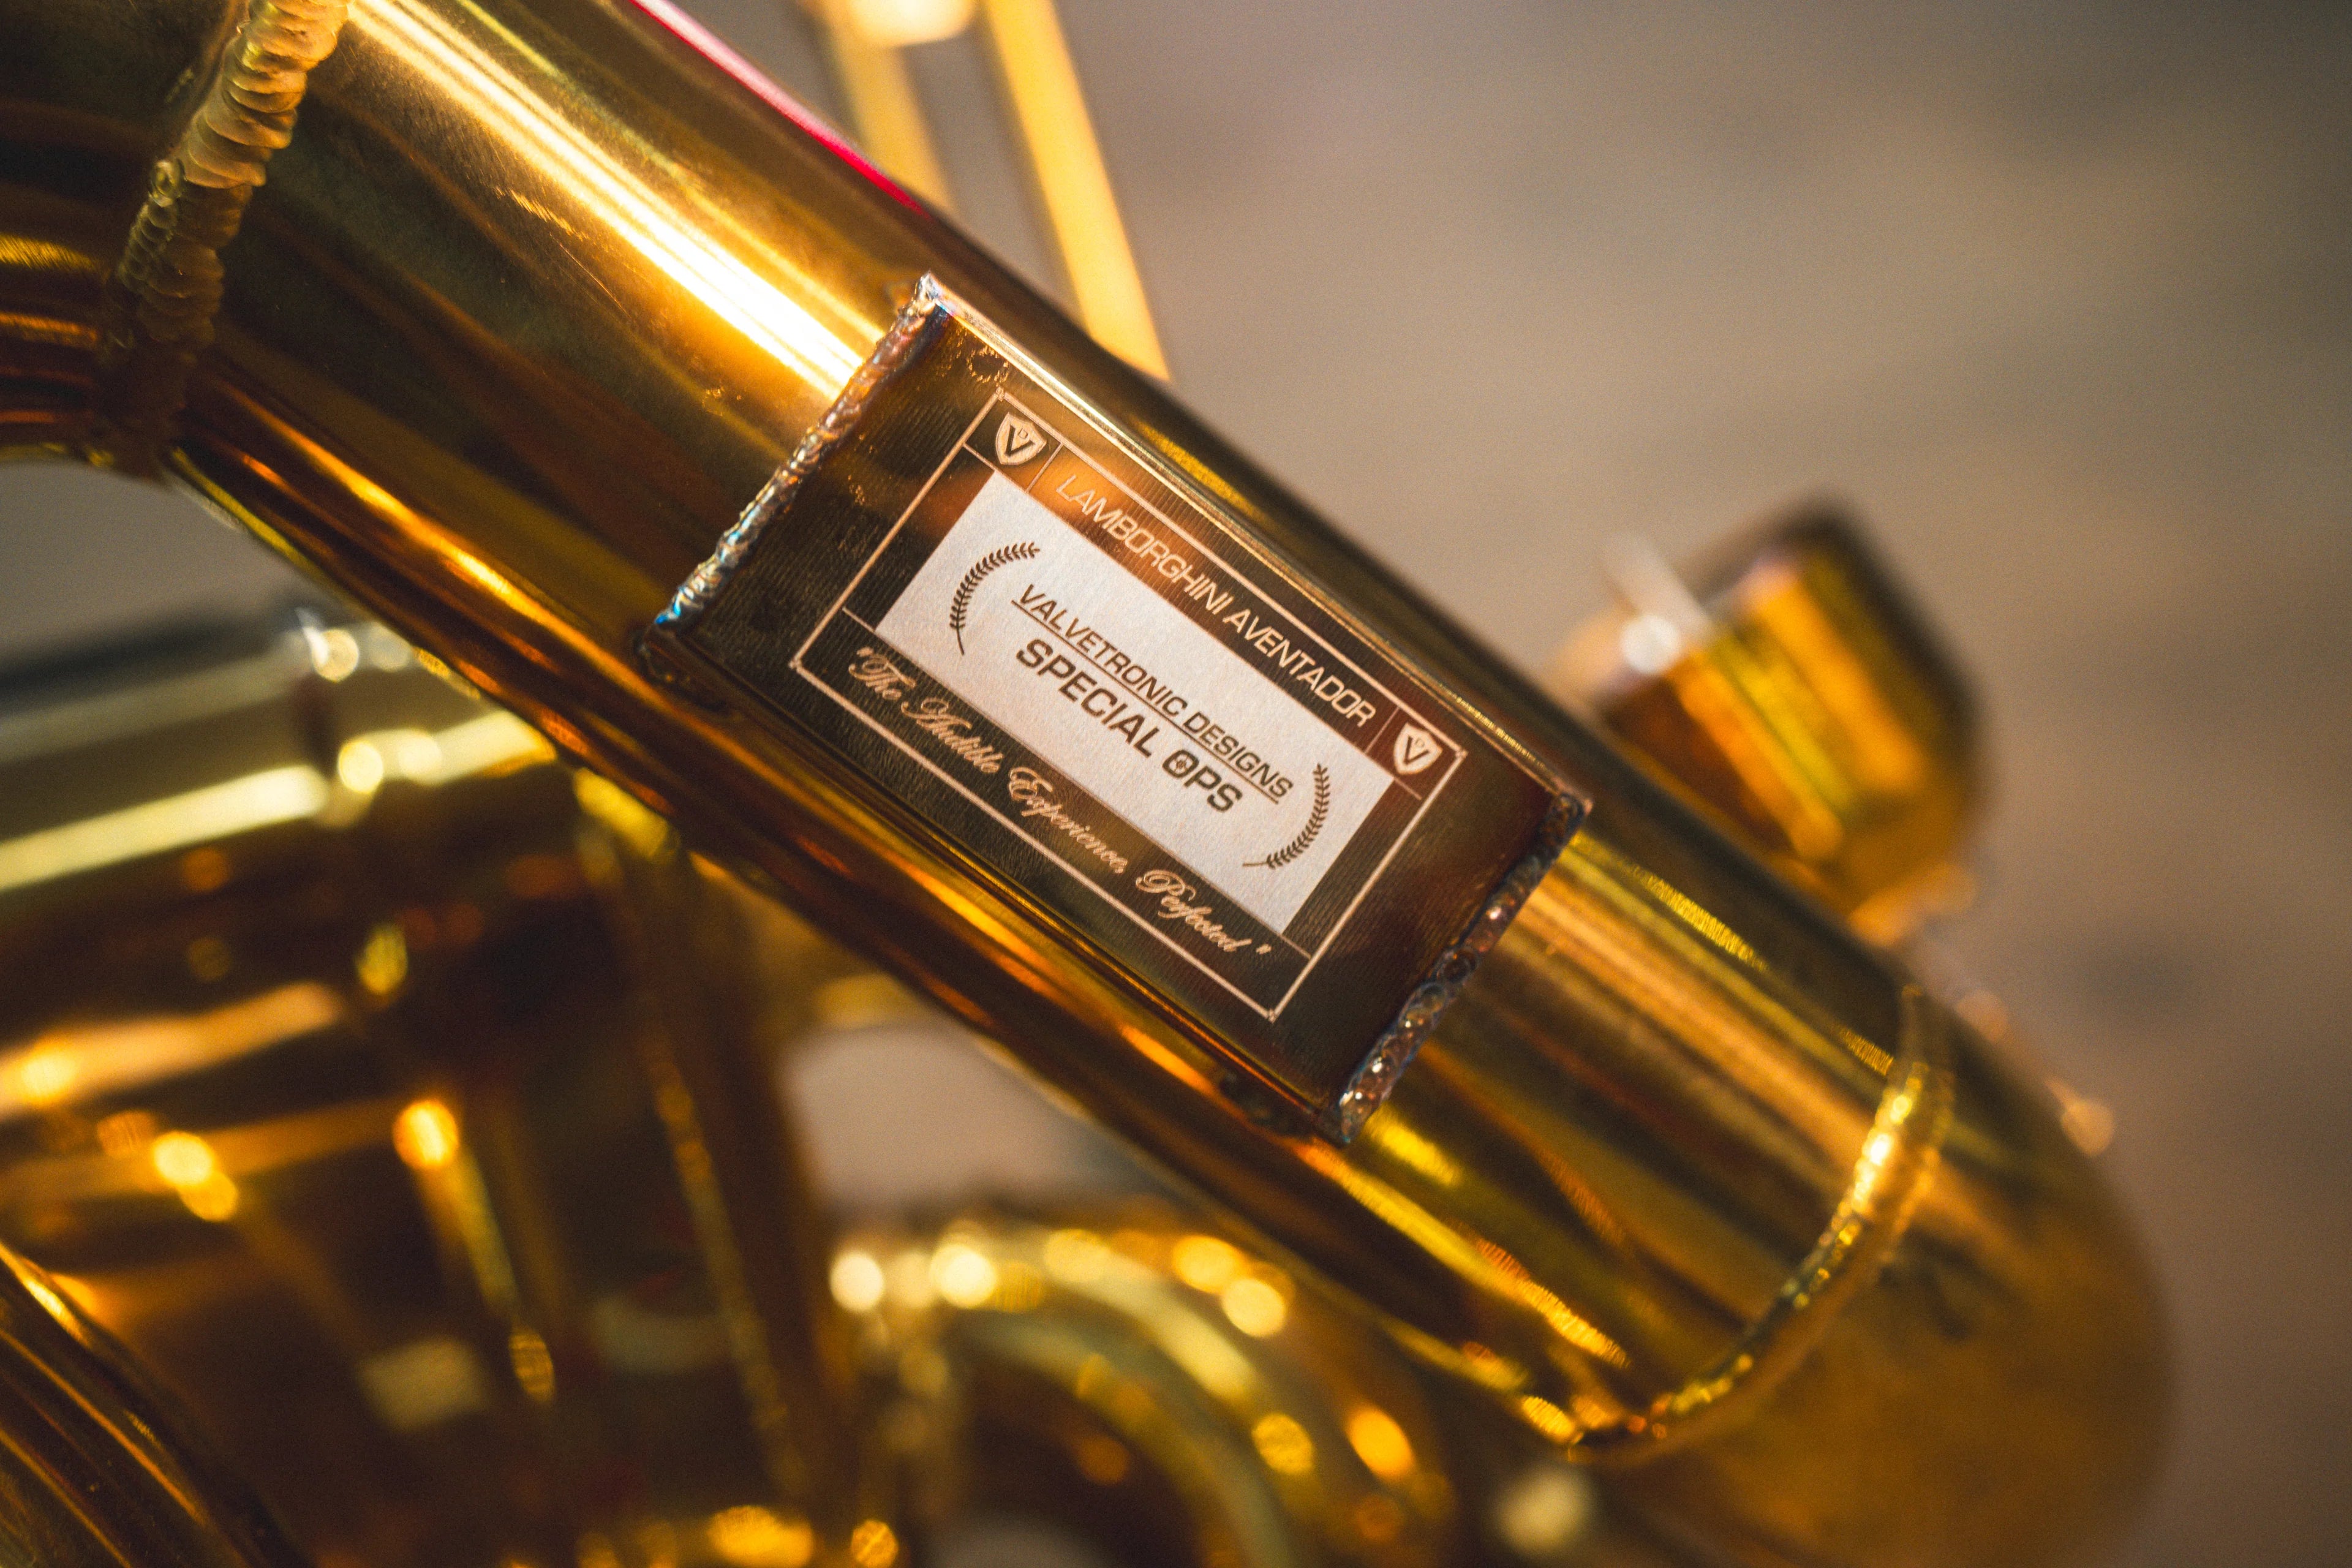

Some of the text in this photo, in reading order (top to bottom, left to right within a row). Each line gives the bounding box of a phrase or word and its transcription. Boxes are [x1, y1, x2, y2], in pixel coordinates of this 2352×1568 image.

[1019, 584, 1294, 797] VALVETRONIC DESIGNS
[1055, 475, 1376, 727] LAMBORGHINI AVENTADOR
[901, 697, 1003, 773] Audible
[1016, 638, 1243, 813] SPECIAL OPS
